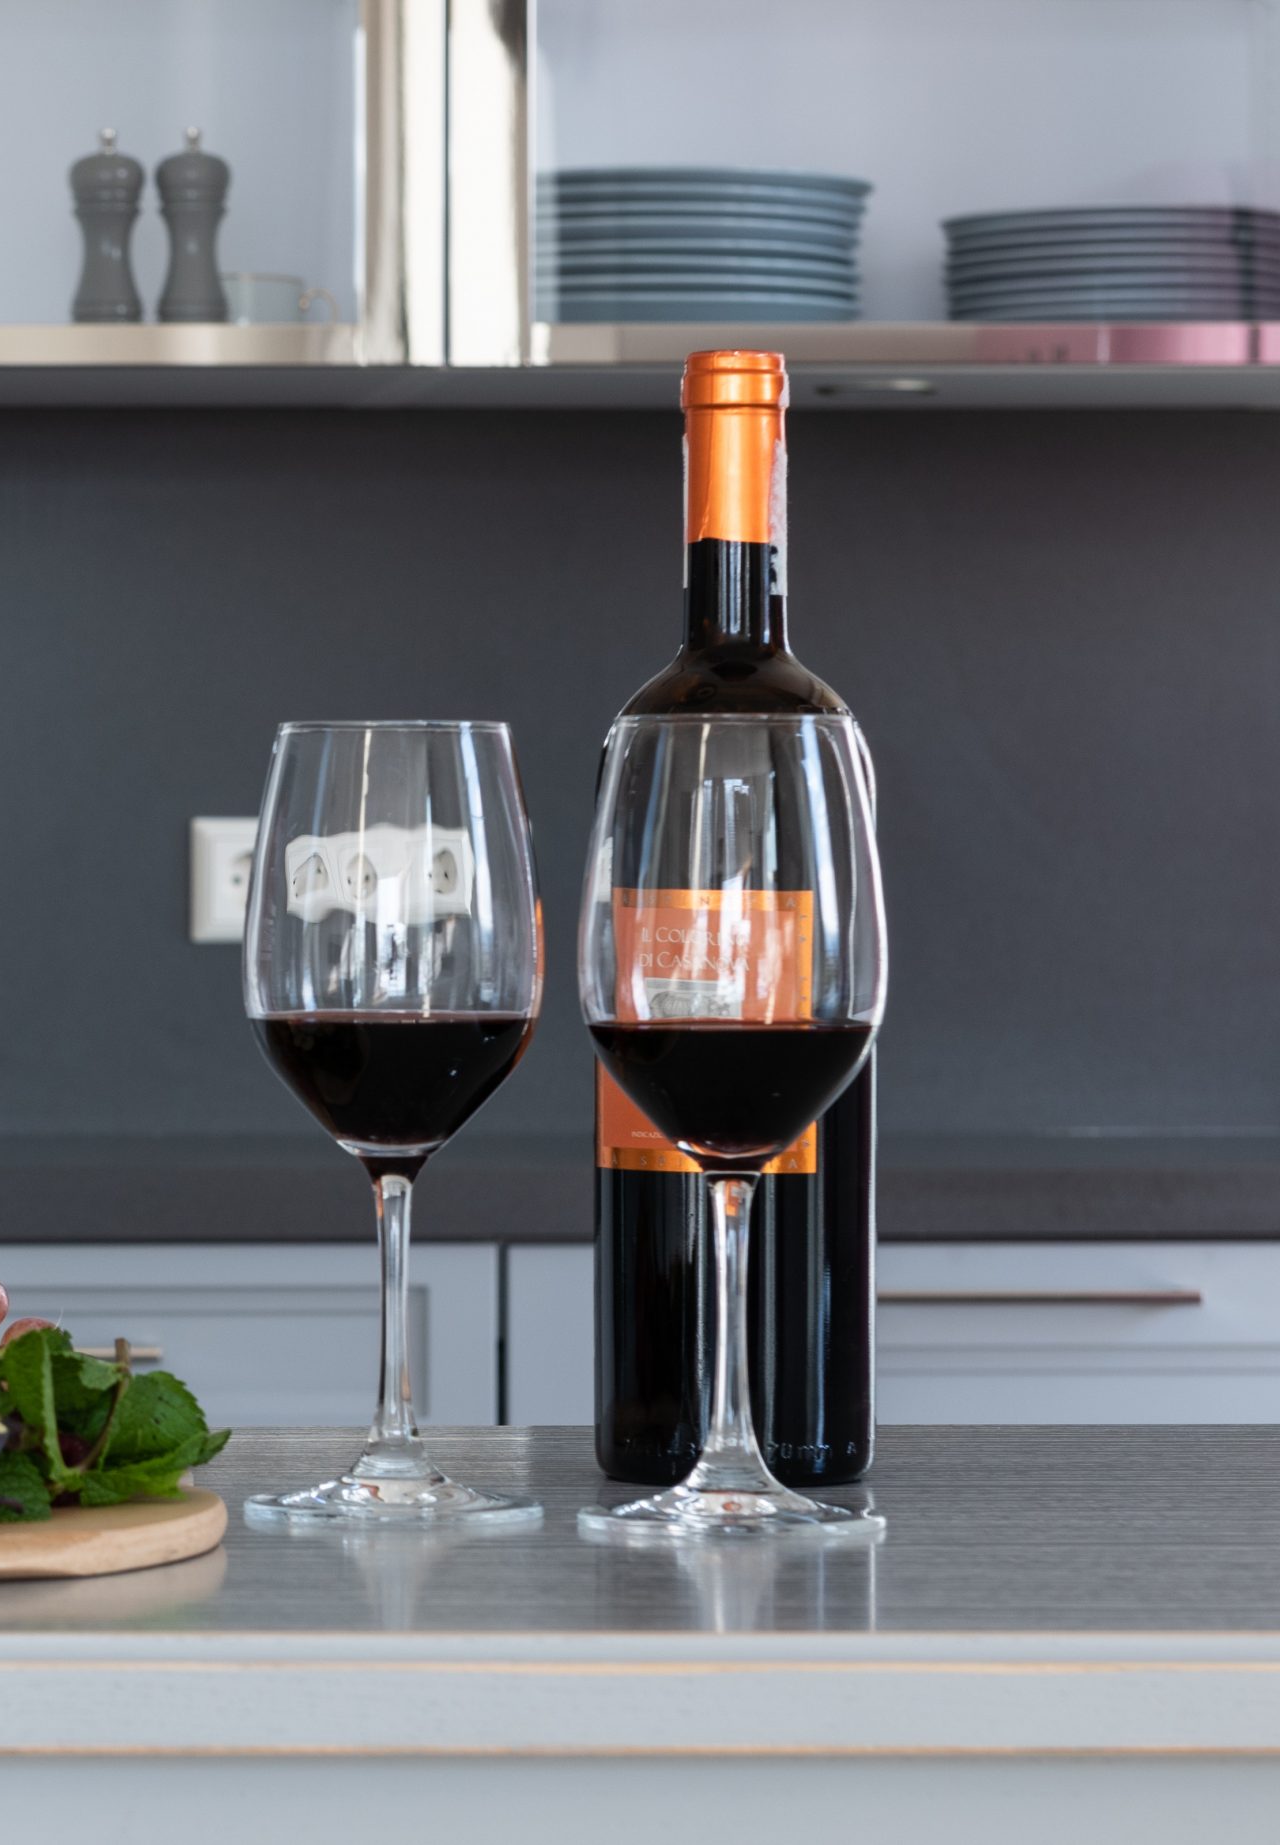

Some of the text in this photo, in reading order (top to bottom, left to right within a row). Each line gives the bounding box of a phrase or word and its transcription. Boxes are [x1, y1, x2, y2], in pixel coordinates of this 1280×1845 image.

[641, 927, 652, 943] IL
[639, 951, 750, 971] DI CASNOVA
